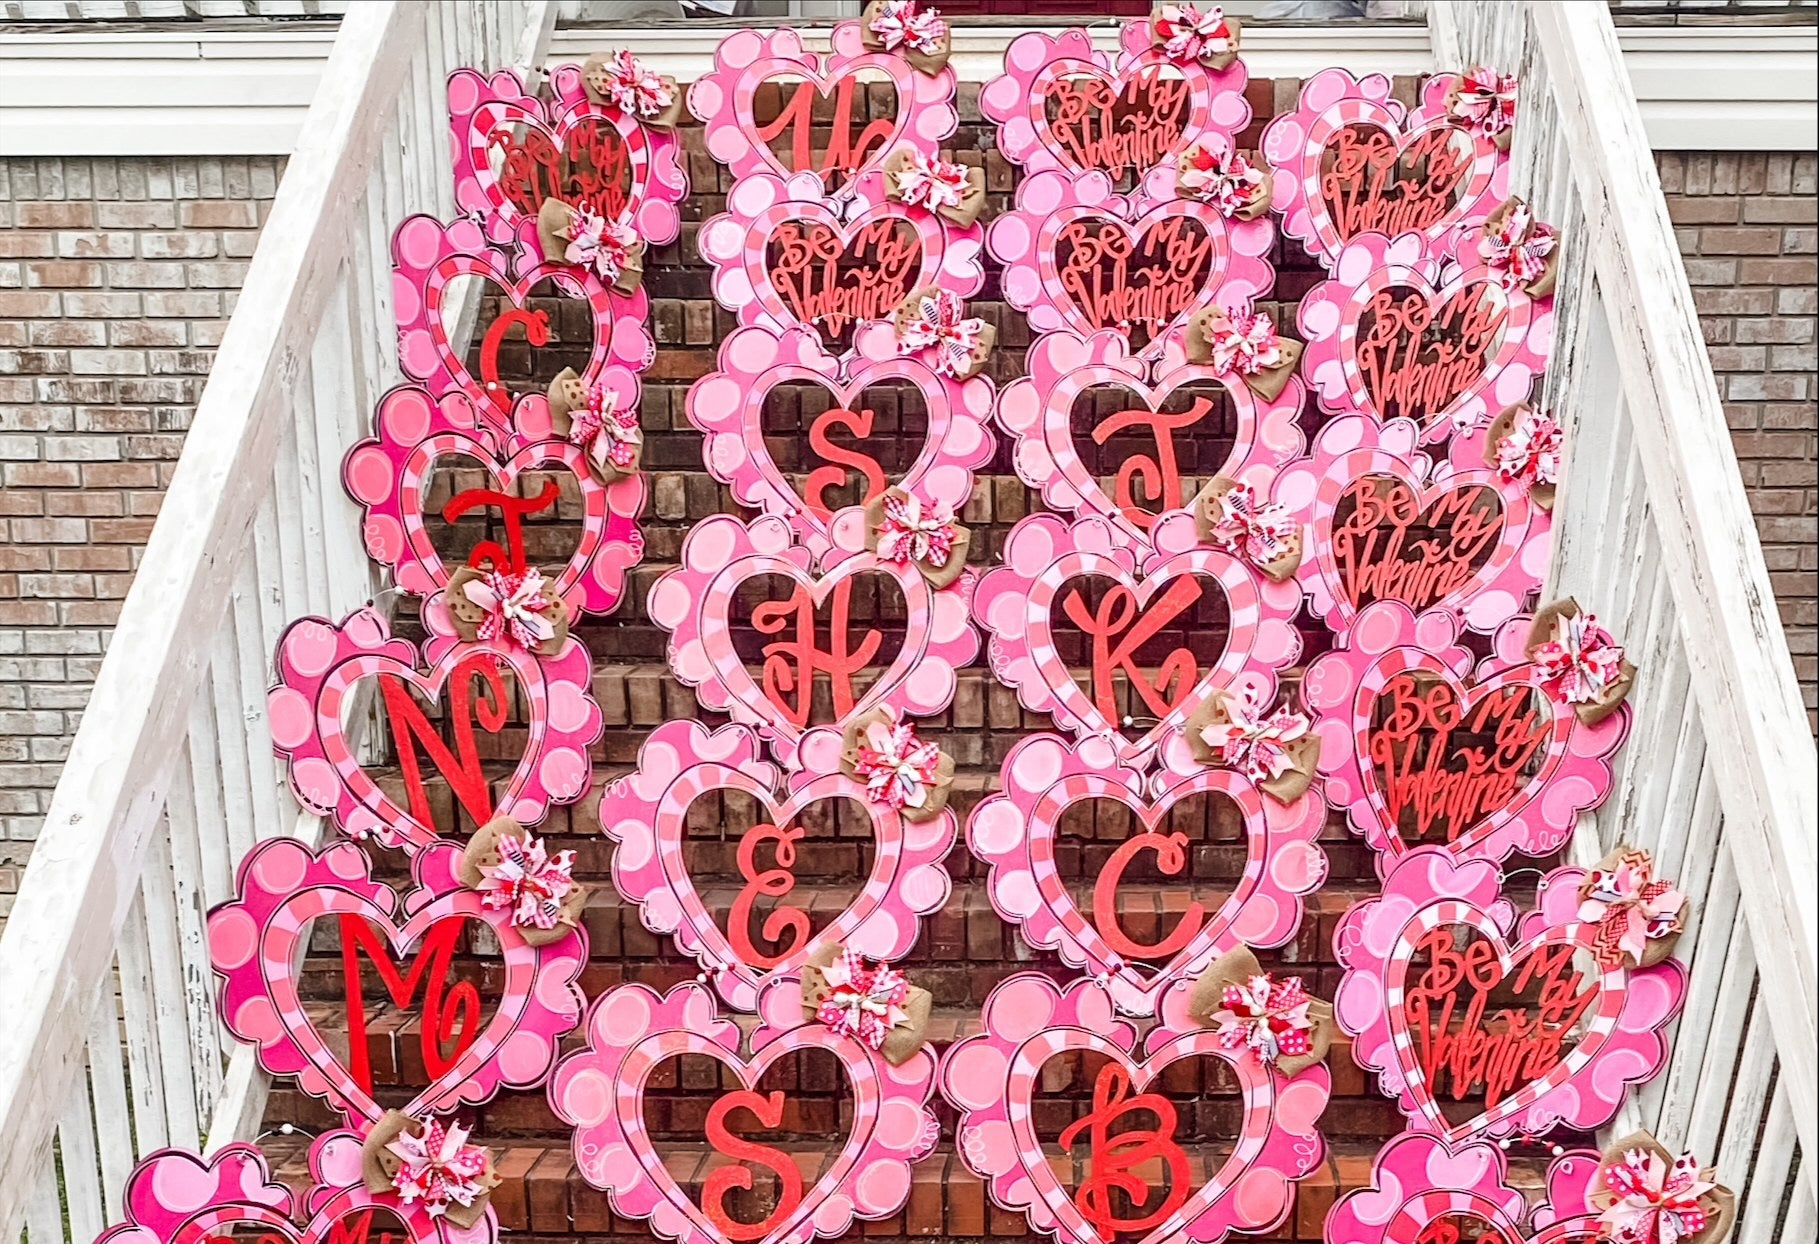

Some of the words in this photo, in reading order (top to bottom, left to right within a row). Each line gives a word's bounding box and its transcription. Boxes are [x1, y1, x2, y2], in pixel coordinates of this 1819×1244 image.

[1046, 79, 1117, 123] Be
[1128, 65, 1190, 124] My
[489, 129, 561, 177] Be
[571, 119, 627, 188] My
[1052, 110, 1182, 181] Valentine
[1327, 129, 1400, 180] Be
[1407, 129, 1473, 197] My
[769, 224, 843, 272] Be
[855, 218, 921, 283] My
[1058, 223, 1134, 271] Be
[1144, 216, 1212, 282] My
[1322, 169, 1446, 241] Valentine
[770, 261, 906, 338] Valentine
[1062, 259, 1196, 338] Valentine
[1363, 293, 1432, 348] Be
[1441, 282, 1508, 358] My
[1358, 334, 1480, 425] Valentine
[804, 408, 886, 525] S
[1344, 478, 1418, 536] Be
[1428, 487, 1504, 561] My
[1333, 528, 1471, 614] Valentine
[752, 574, 882, 731] H
[1063, 573, 1203, 730] K
[379, 654, 508, 832] N
[1380, 675, 1462, 741] Be
[1471, 687, 1552, 773] My
[1371, 732, 1516, 841] Valentine
[728, 823, 811, 968] E
[1093, 832, 1204, 958] C
[339, 911, 480, 1102] M
[1417, 930, 1503, 999] Be
[1512, 945, 1601, 1037] My
[1405, 988, 1562, 1110] Valentine
[701, 1090, 801, 1241] S
[1059, 1061, 1191, 1243] B
